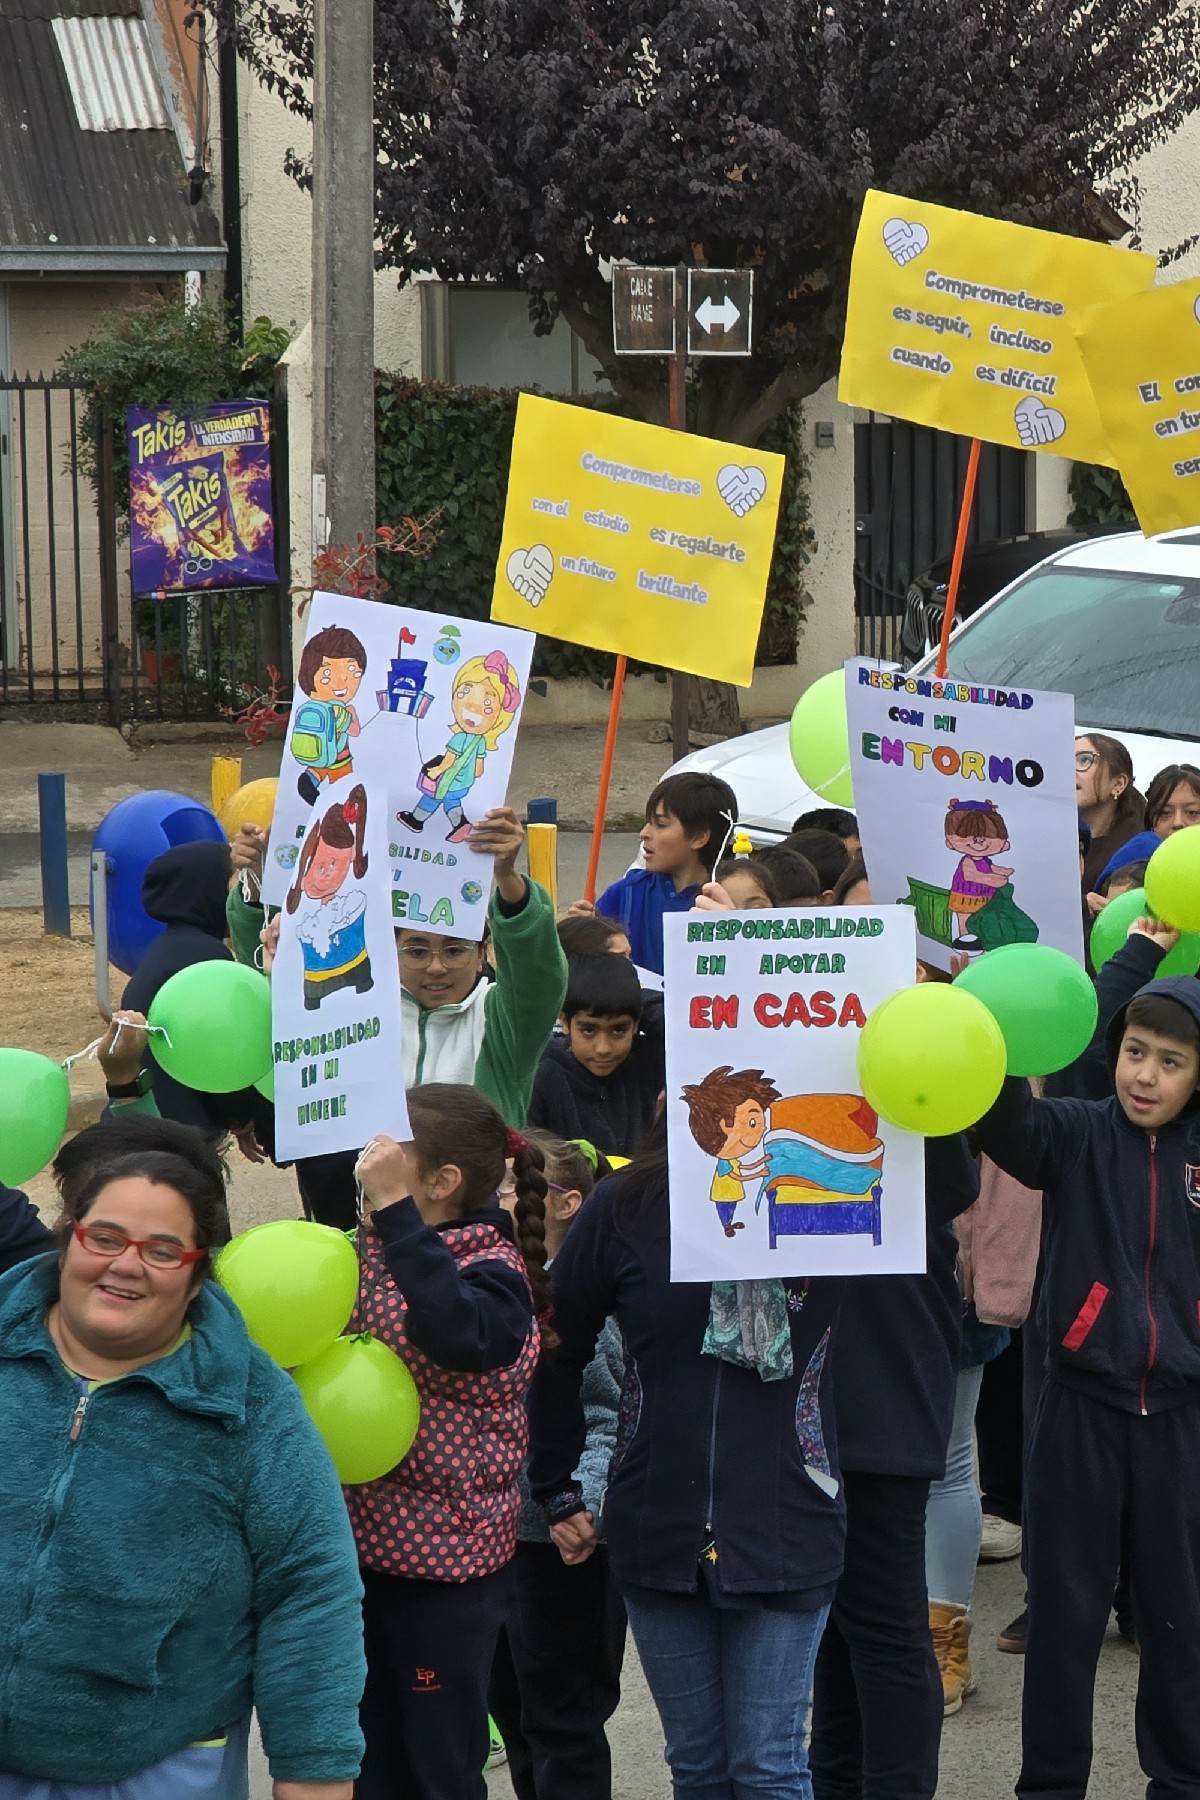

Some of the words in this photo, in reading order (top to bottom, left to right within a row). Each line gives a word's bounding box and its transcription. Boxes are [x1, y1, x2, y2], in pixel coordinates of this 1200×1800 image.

[925, 270, 1064, 316] Comprometerse
[893, 306, 912, 321] es
[916, 312, 972, 339] seguir,
[990, 326, 1052, 354] incluso
[893, 348, 950, 374] cuando
[976, 366, 995, 381] es
[1000, 368, 1056, 395] difícil
[1139, 383, 1161, 403] El
[132, 420, 186, 464] Takis
[201, 428, 254, 445] INTENSIDAD
[205, 413, 259, 433] VERDADERA
[1155, 419, 1178, 436] en
[581, 453, 701, 496] Comprometerse
[167, 472, 221, 528] Takis
[532, 498, 553, 512] con
[555, 502, 568, 516] el
[583, 511, 630, 533] estudio
[650, 527, 666, 542] es
[670, 531, 745, 563] regalarte
[562, 556, 576, 569] un
[577, 559, 617, 581] futuro
[637, 572, 708, 604] brillante
[858, 667, 1033, 710] RESPONSABILIDAD
[888, 706, 924, 727] CON
[934, 715, 957, 733] MI
[862, 732, 1043, 787] ENTORNO
[688, 918, 884, 942] RESPONSABILIDAD
[696, 955, 726, 975] EN
[759, 953, 846, 974] APOYAR
[689, 995, 739, 1030] EN
[754, 991, 867, 1028] CASA
[274, 1016, 380, 1063] RESPONSABILIDAD
[302, 1064, 317, 1088] EN
[324, 1058, 338, 1080] MI
[298, 1094, 346, 1126] HIGIENE
[416, 1668, 434, 1684] EP
